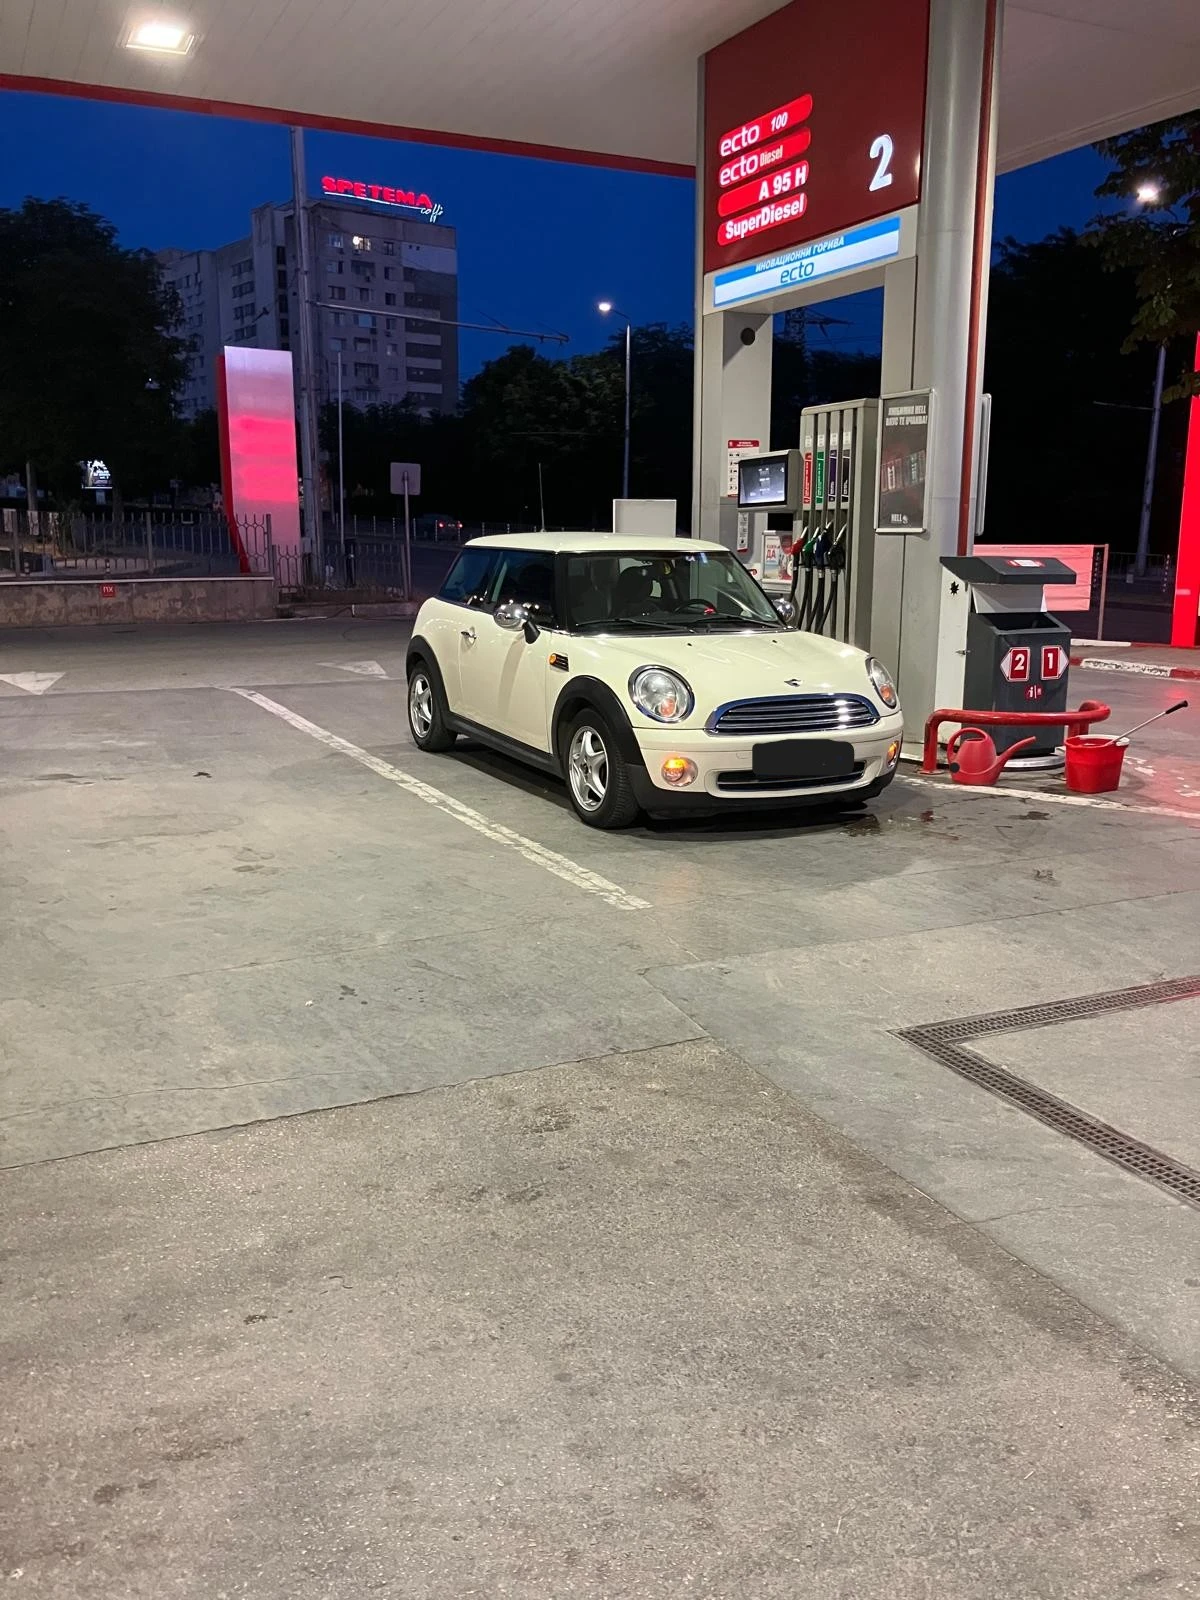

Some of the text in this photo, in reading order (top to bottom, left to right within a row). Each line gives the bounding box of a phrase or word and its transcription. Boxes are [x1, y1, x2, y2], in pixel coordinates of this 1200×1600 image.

[720, 112, 788, 157] ecto 100
[719, 145, 783, 186] ecto Diesel
[868, 134, 893, 192] 2
[322, 176, 433, 208] SPETEMA
[758, 165, 807, 201] A 95 H
[725, 193, 804, 239] SuperDiesel
[755, 235, 845, 273] ИНОВАЦИОННИ ГОРИВА
[780, 261, 815, 284] ecto
[1014, 653, 1025, 671] 2
[1047, 652, 1054, 669] 1
